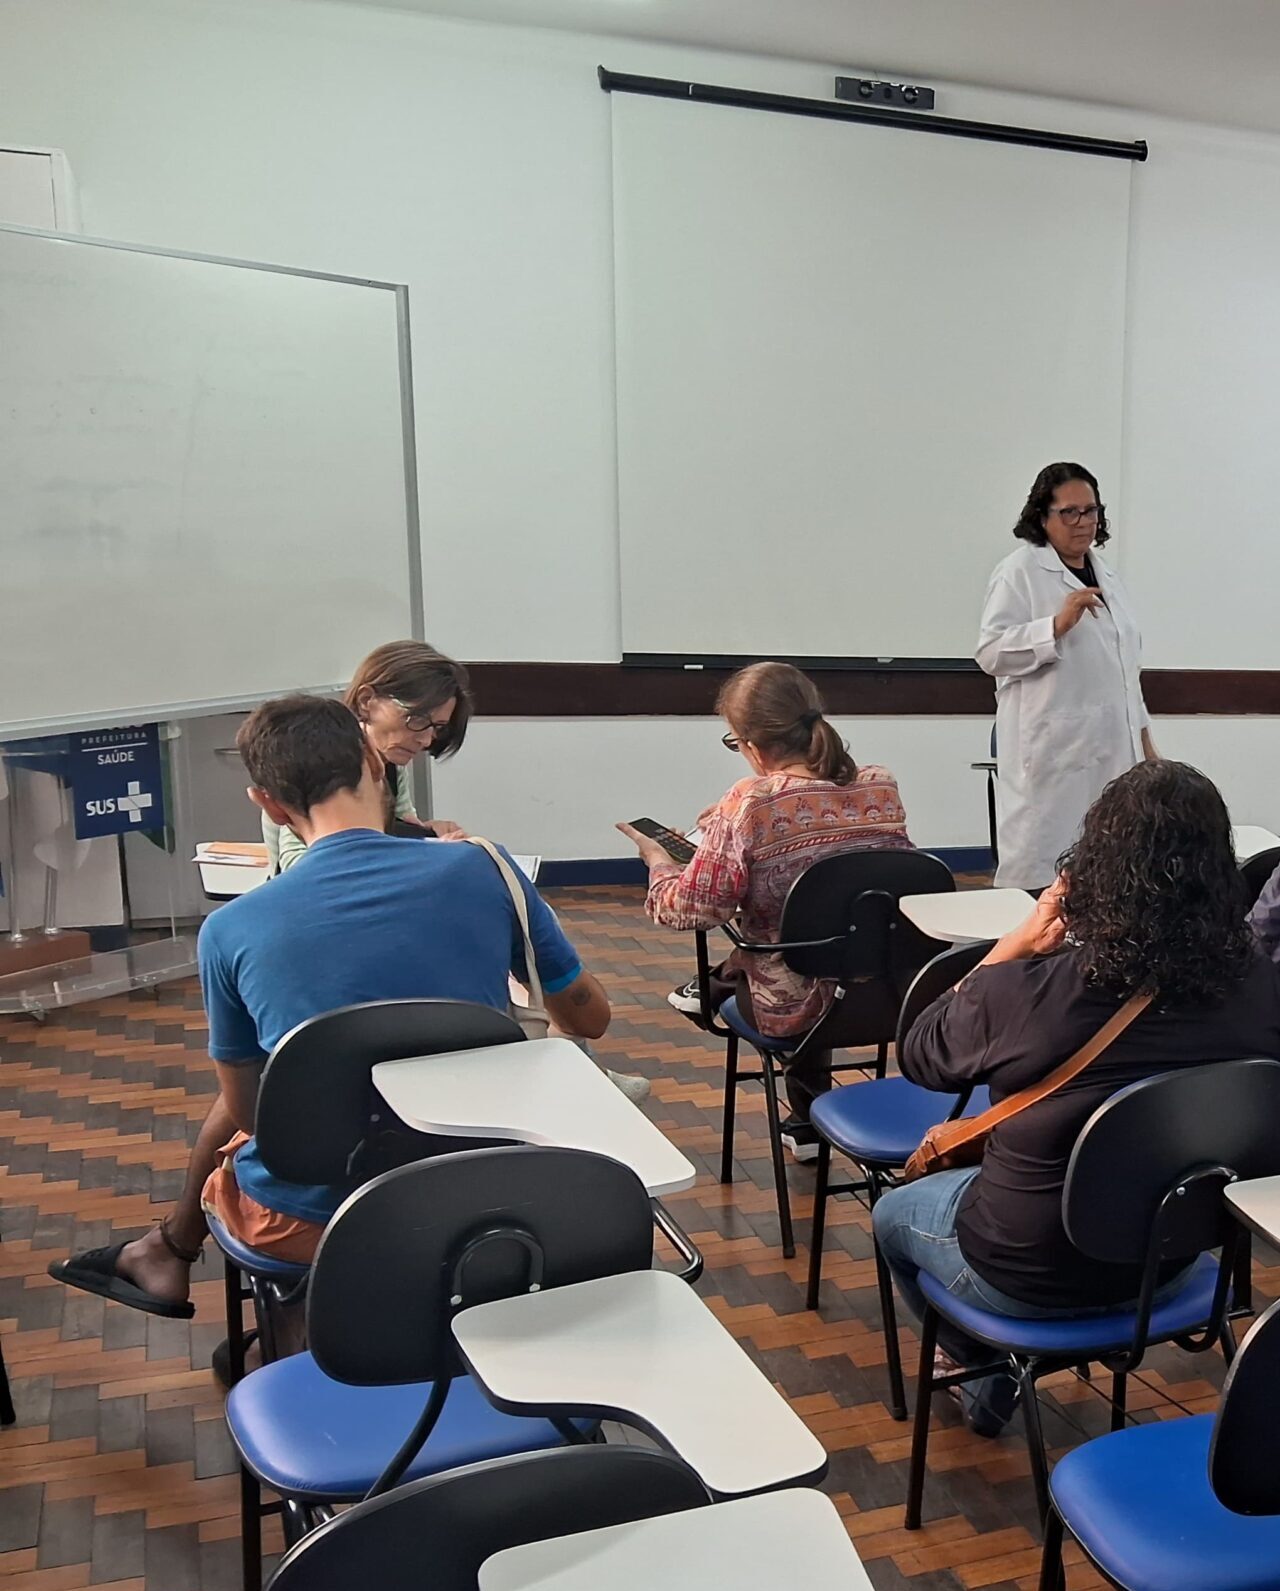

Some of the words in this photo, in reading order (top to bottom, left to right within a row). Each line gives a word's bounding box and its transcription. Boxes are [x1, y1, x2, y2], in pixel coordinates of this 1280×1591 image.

[81, 732, 147, 744] PREFEITURA
[97, 749, 135, 765] SAÚDE
[85, 798, 116, 816] SUS
